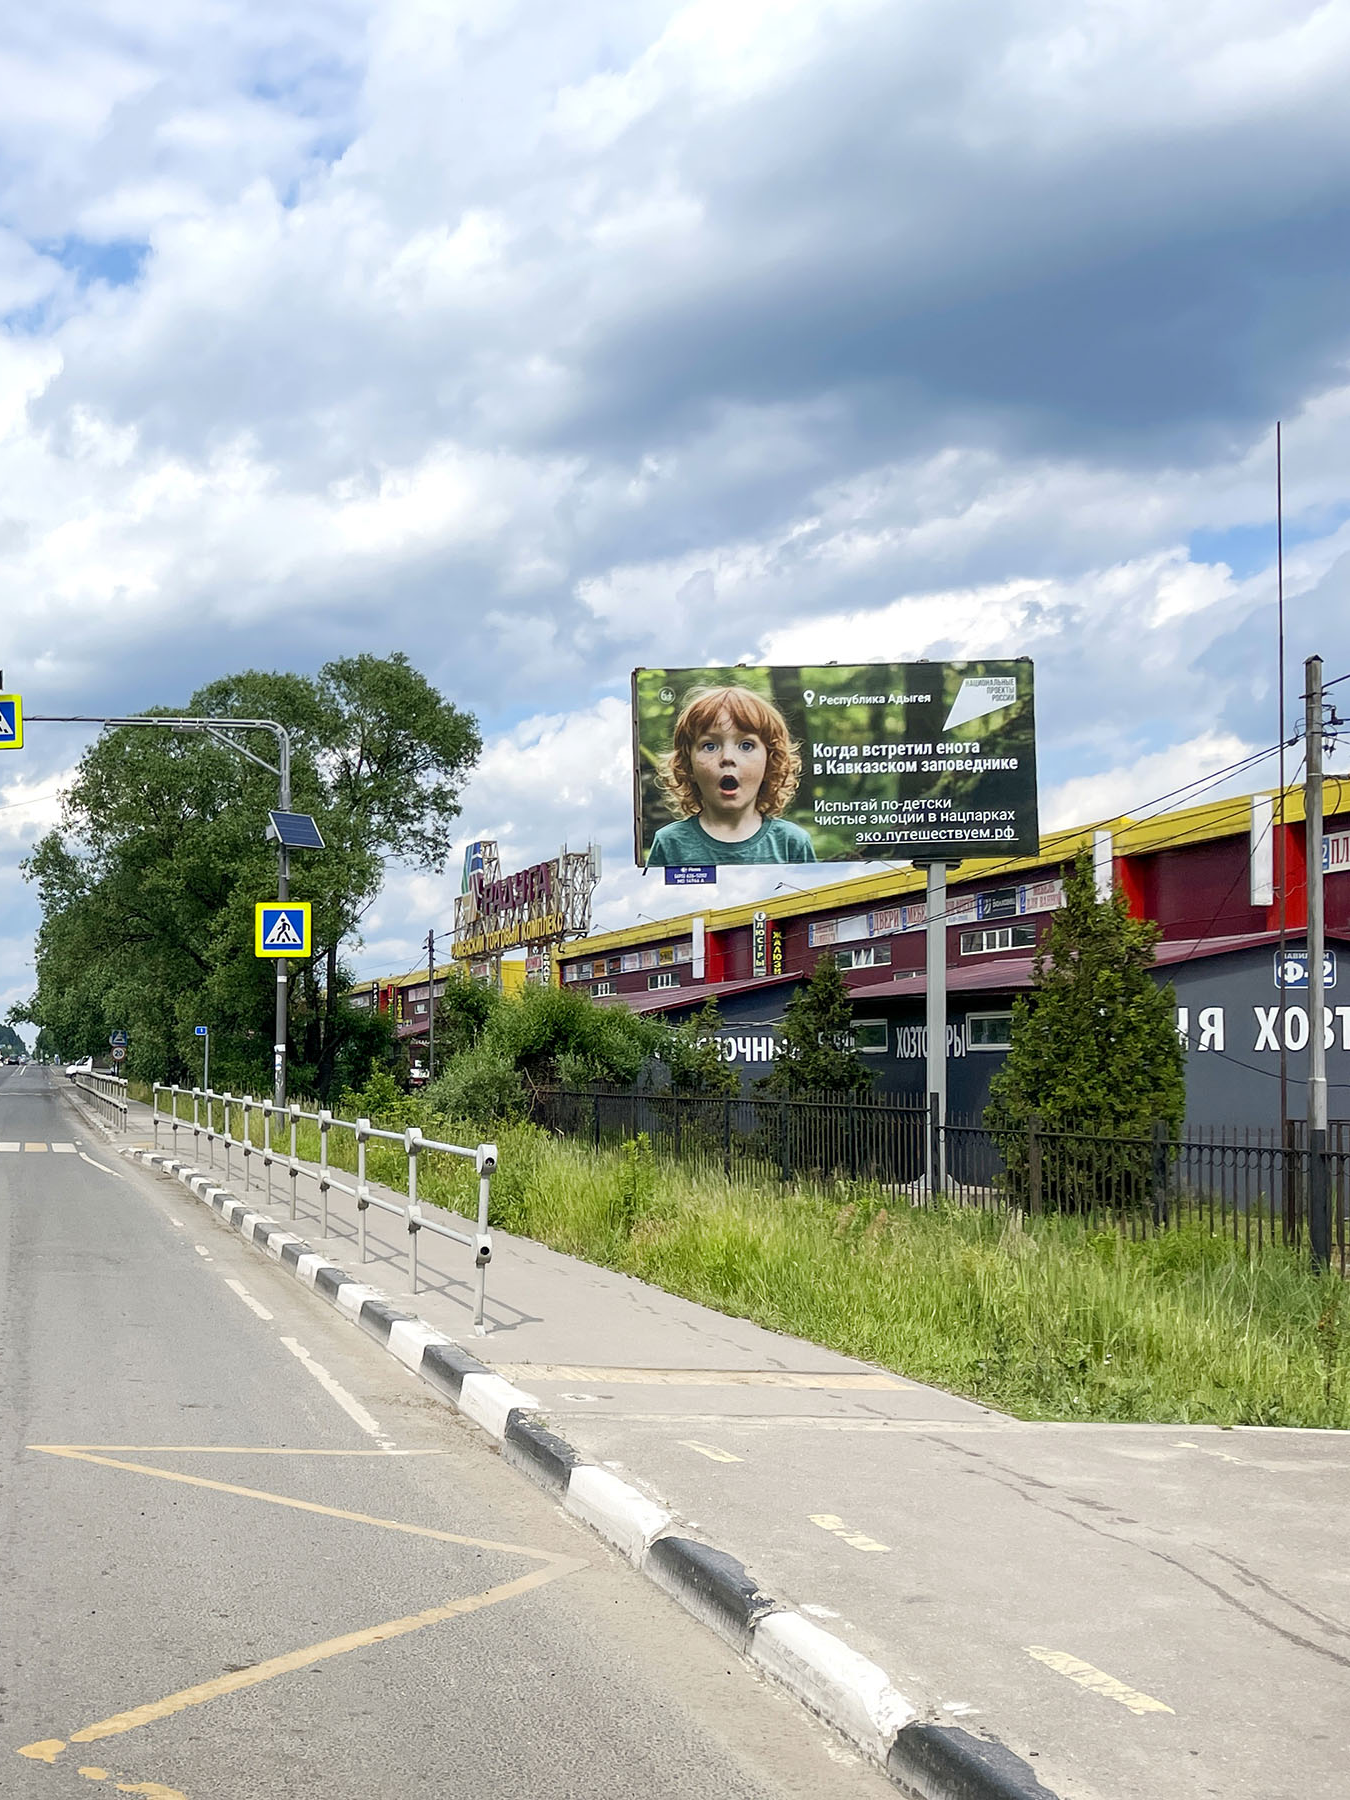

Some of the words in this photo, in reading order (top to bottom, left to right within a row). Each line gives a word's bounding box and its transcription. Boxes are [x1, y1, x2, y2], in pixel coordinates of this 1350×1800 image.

[986, 686, 1015, 694] ПРОЕКТЫ
[818, 694, 886, 707] Республика
[887, 693, 931, 705] Адыгея
[812, 743, 858, 759] Когда
[862, 743, 932, 758] встретил
[936, 741, 980, 754] енота
[813, 763, 823, 775] в
[826, 760, 917, 775] Кавказском
[921, 757, 1019, 773] заповеднике
[814, 799, 878, 812] Испытай
[881, 798, 952, 811] по-детски
[814, 813, 867, 825] чистые
[870, 813, 924, 825] эмоции
[928, 812, 936, 822] в
[940, 810, 1016, 824] нацпарках
[855, 825, 1016, 843] эко.путешествуем.рф
[483, 863, 551, 917] РАДУГА
[873, 908, 900, 933] ДВЕРИ
[755, 922, 765, 966] ЛЮСТРЫ
[772, 931, 783, 975] ЖАЛЮЗИ
[896, 1024, 967, 1059] ХОЗТОРЫ
